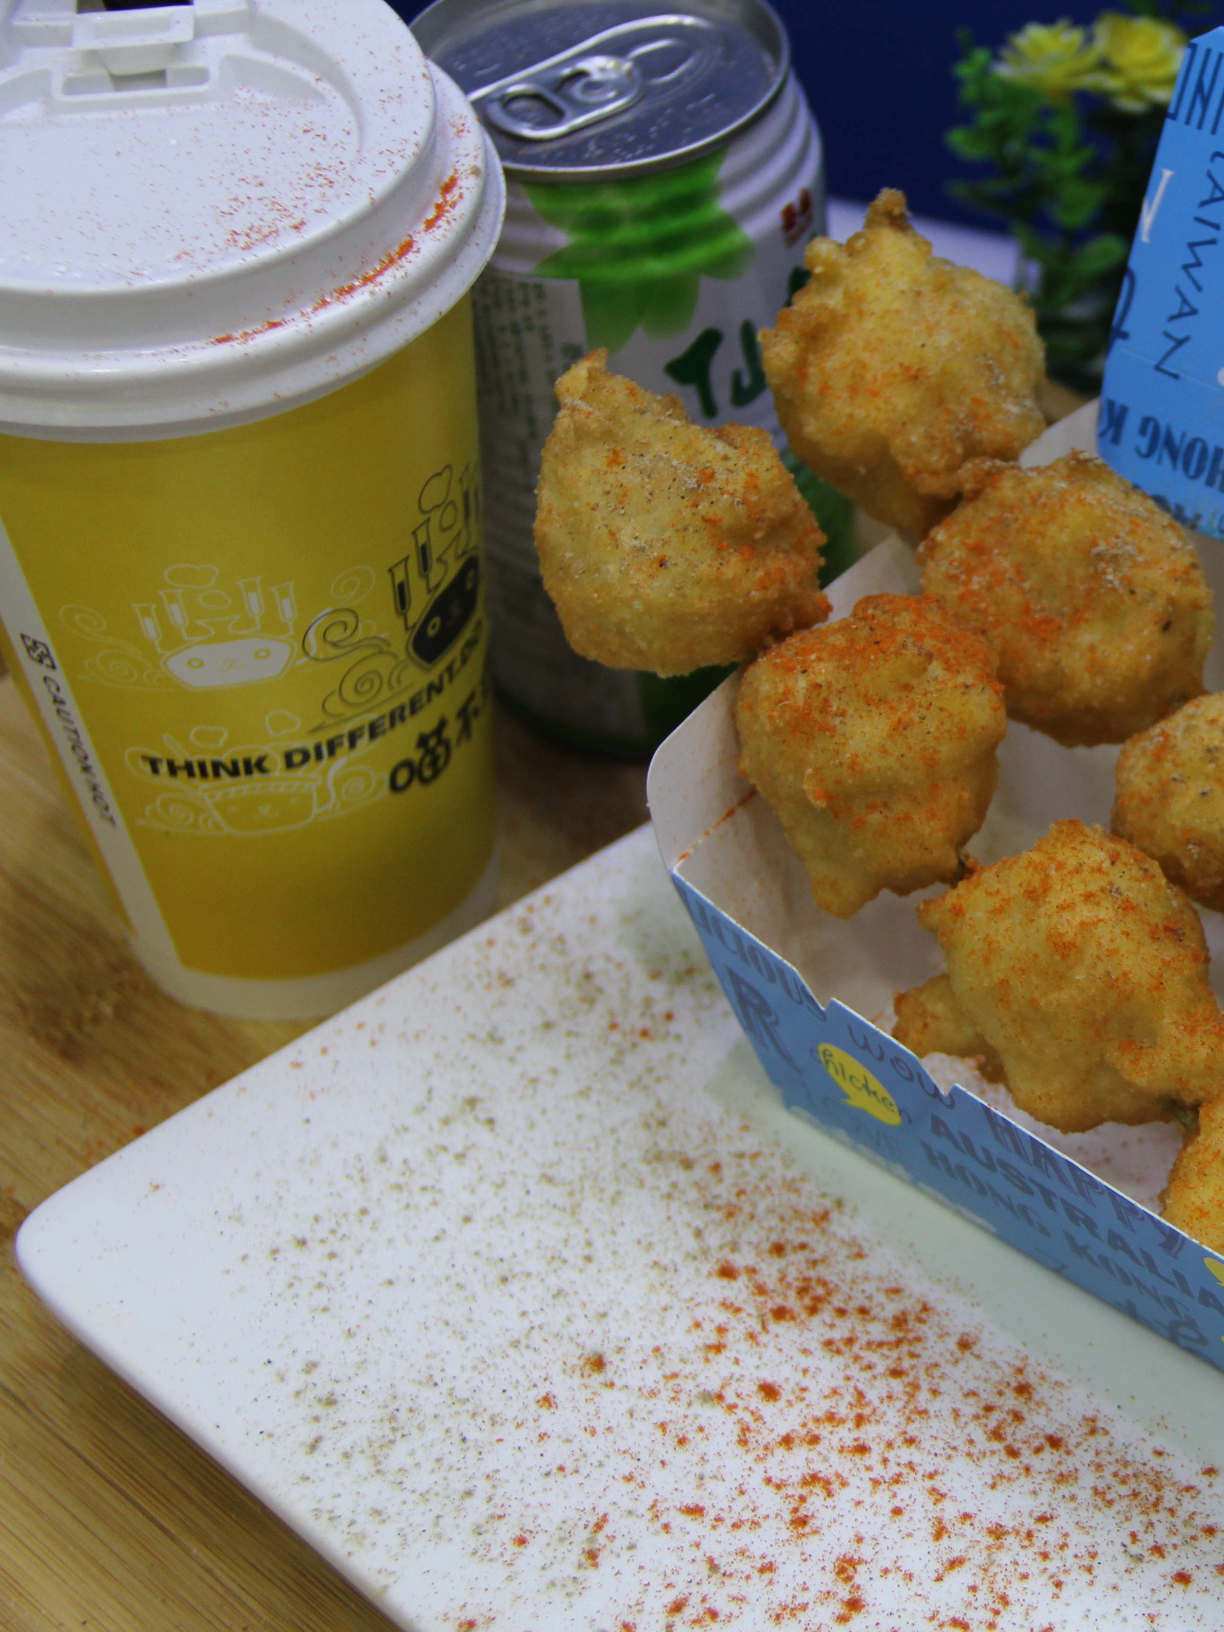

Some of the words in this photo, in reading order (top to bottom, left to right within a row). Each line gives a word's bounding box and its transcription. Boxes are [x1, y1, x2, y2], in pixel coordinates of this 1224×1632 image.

[43, 675, 95, 777] CAUTION
[86, 779, 116, 828] HOT
[141, 754, 269, 779] THINK
[918, 1138, 1052, 1239] HONG
[1062, 1229, 1190, 1324] KONG
